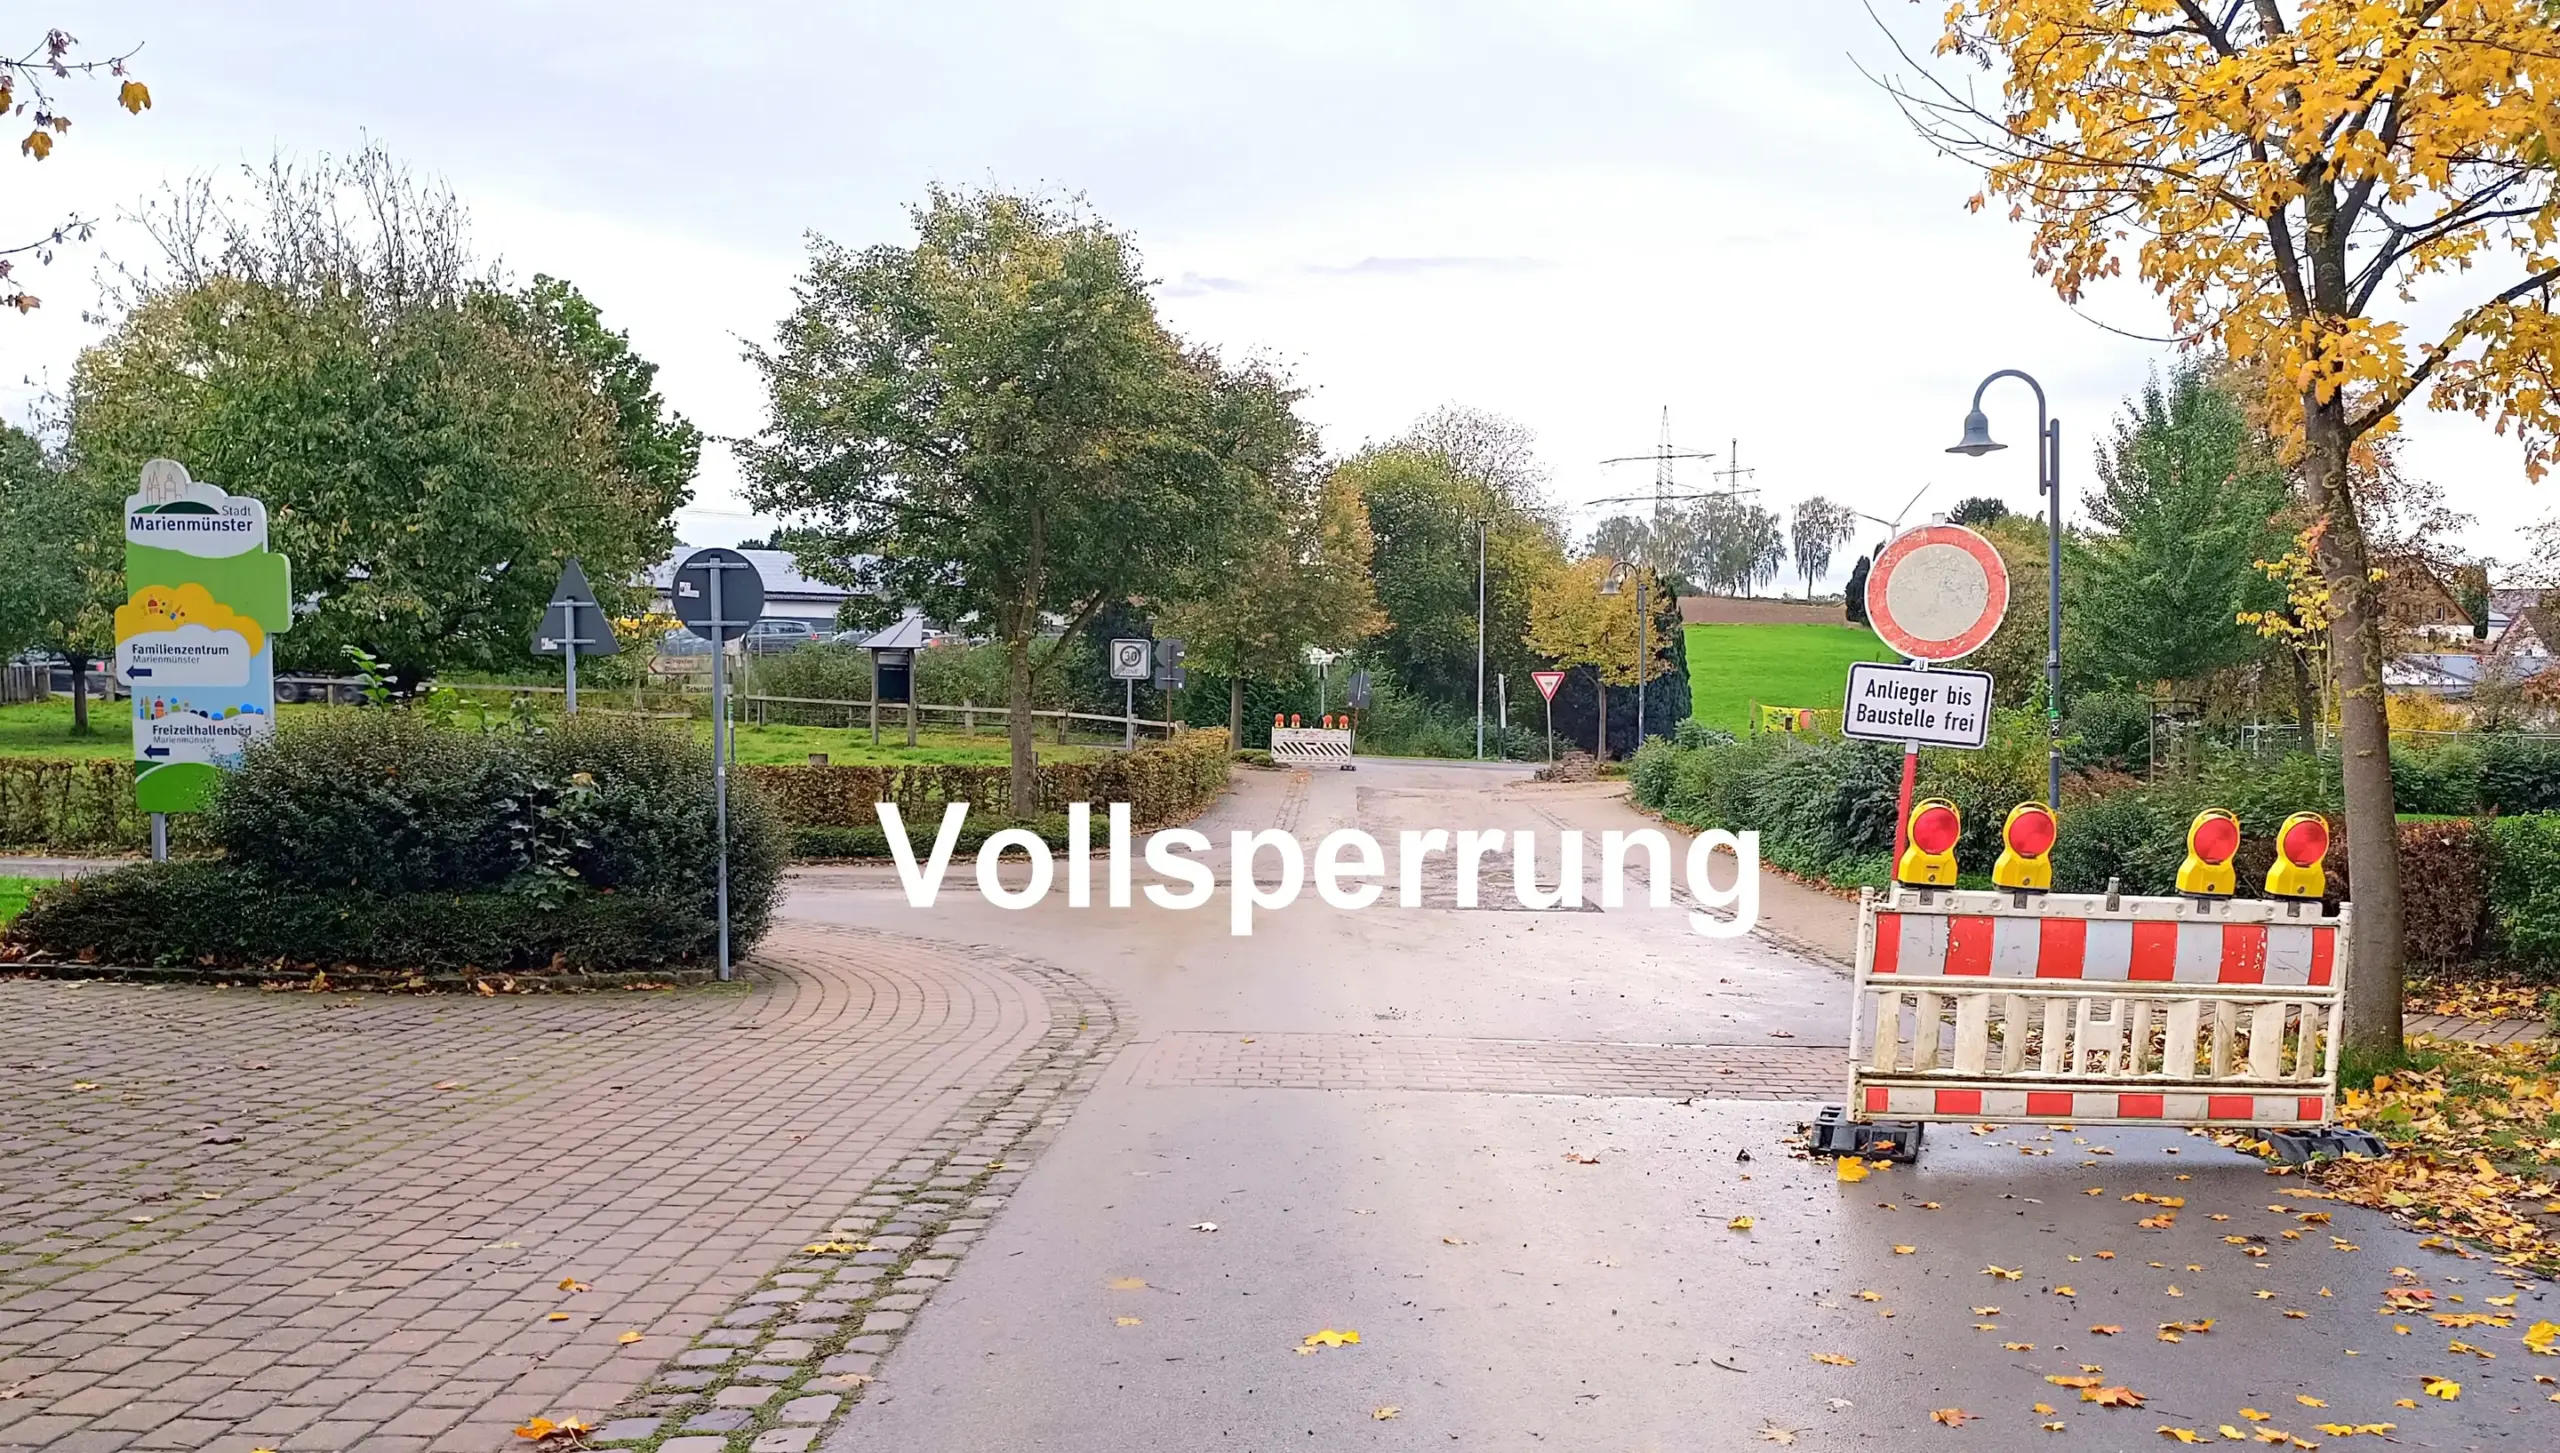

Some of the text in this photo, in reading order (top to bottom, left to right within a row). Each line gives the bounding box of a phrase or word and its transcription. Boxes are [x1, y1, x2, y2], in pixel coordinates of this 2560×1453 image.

[221, 505, 252, 517] Stadt
[130, 516, 253, 532] Marienmünster
[132, 644, 229, 656] Familienzentrum
[132, 656, 200, 665] Marienmünster
[1124, 651, 1138, 662] 30
[1865, 679, 1973, 706] Anlieger bis
[1856, 703, 1975, 732] Baustelle frei
[153, 736, 215, 744] Marienmünster
